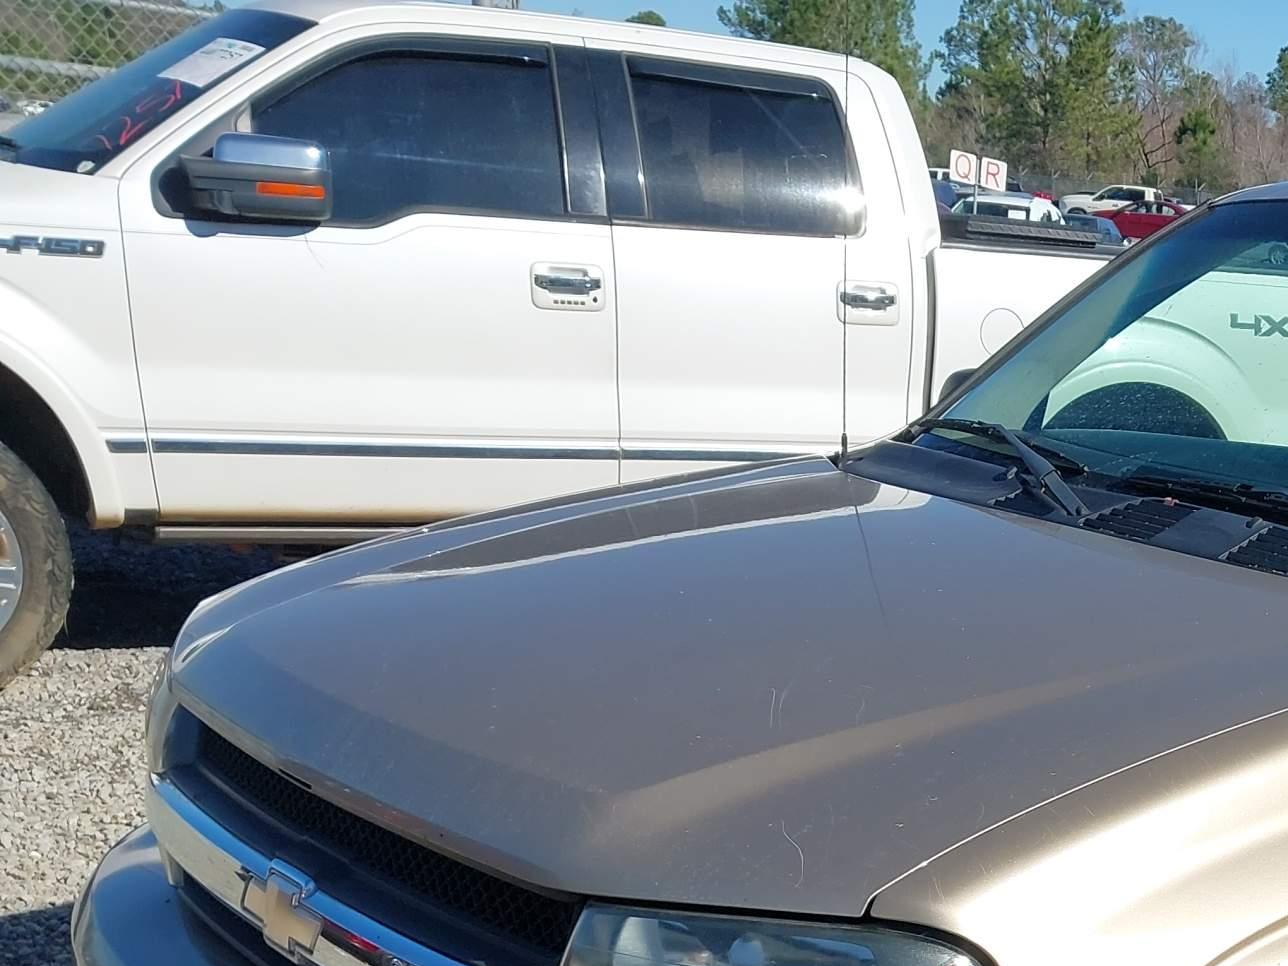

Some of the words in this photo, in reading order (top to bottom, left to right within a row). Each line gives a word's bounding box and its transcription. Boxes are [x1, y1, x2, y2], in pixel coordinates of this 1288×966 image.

[955, 153, 972, 182] Q
[985, 160, 1000, 189] R
[7, 235, 106, 259] F-150
